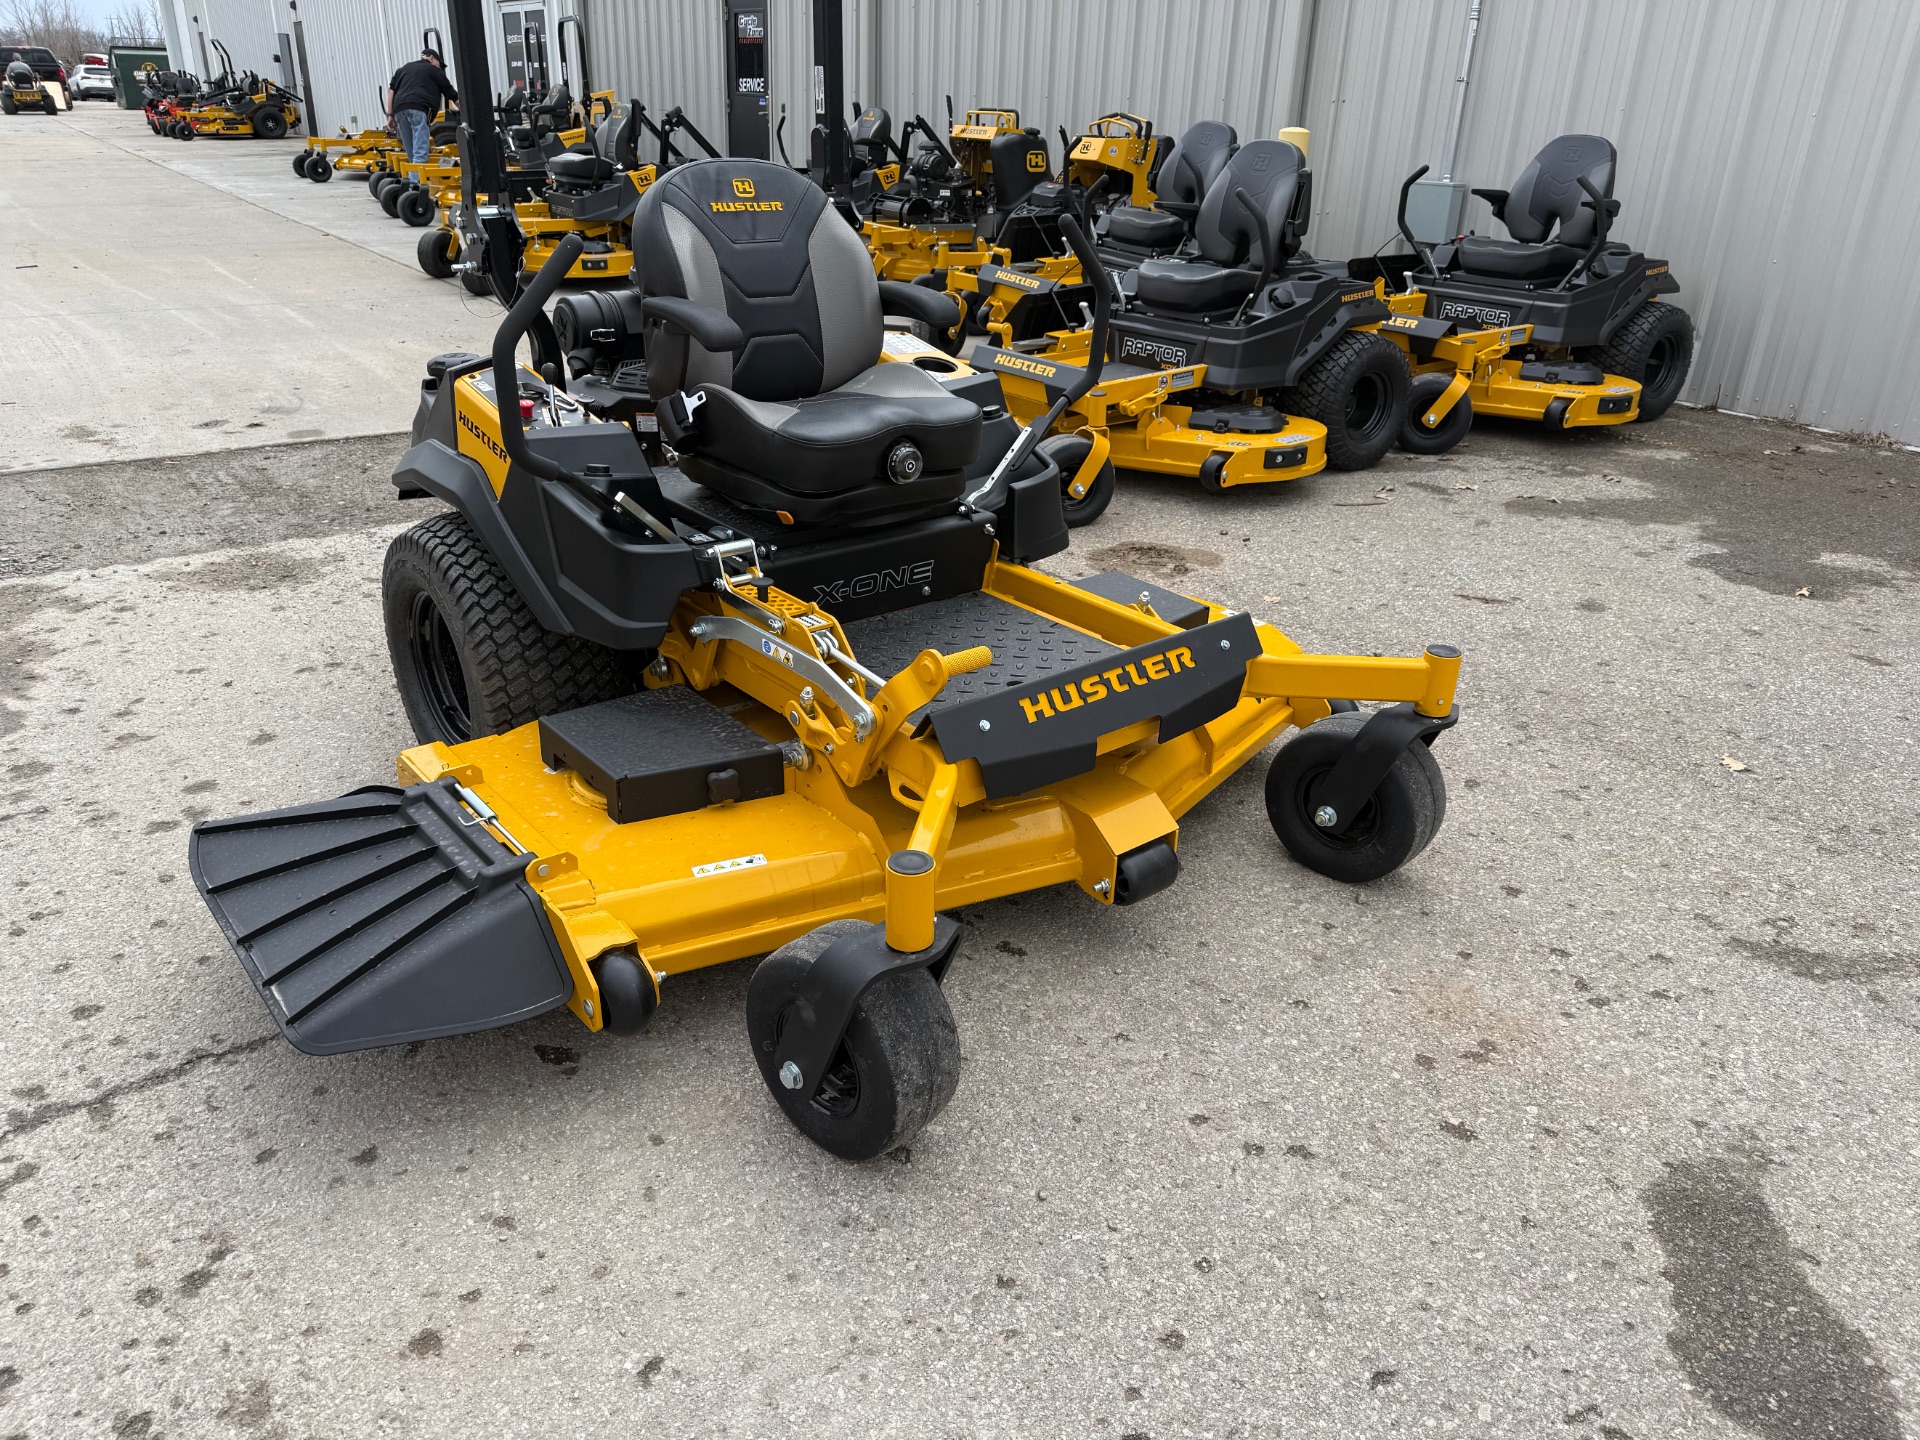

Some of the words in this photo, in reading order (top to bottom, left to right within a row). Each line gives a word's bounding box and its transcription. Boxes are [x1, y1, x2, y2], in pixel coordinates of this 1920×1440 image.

[738, 15, 758, 28] Cycle
[746, 26, 763, 37] Zone
[738, 77, 765, 92] SERVICE
[960, 127, 988, 136] HUSTLER
[710, 201, 784, 212] HUSTLER
[994, 270, 1041, 289] HUSTLER
[1341, 289, 1375, 303] HUSTLER
[1439, 301, 1511, 329] RAPTOR
[1121, 336, 1186, 368] RAPTOR
[993, 353, 1057, 378] HUSTLER
[458, 410, 508, 464] HUSTLER
[812, 559, 935, 607] X-ONE
[1018, 646, 1196, 724] HUSTLER
